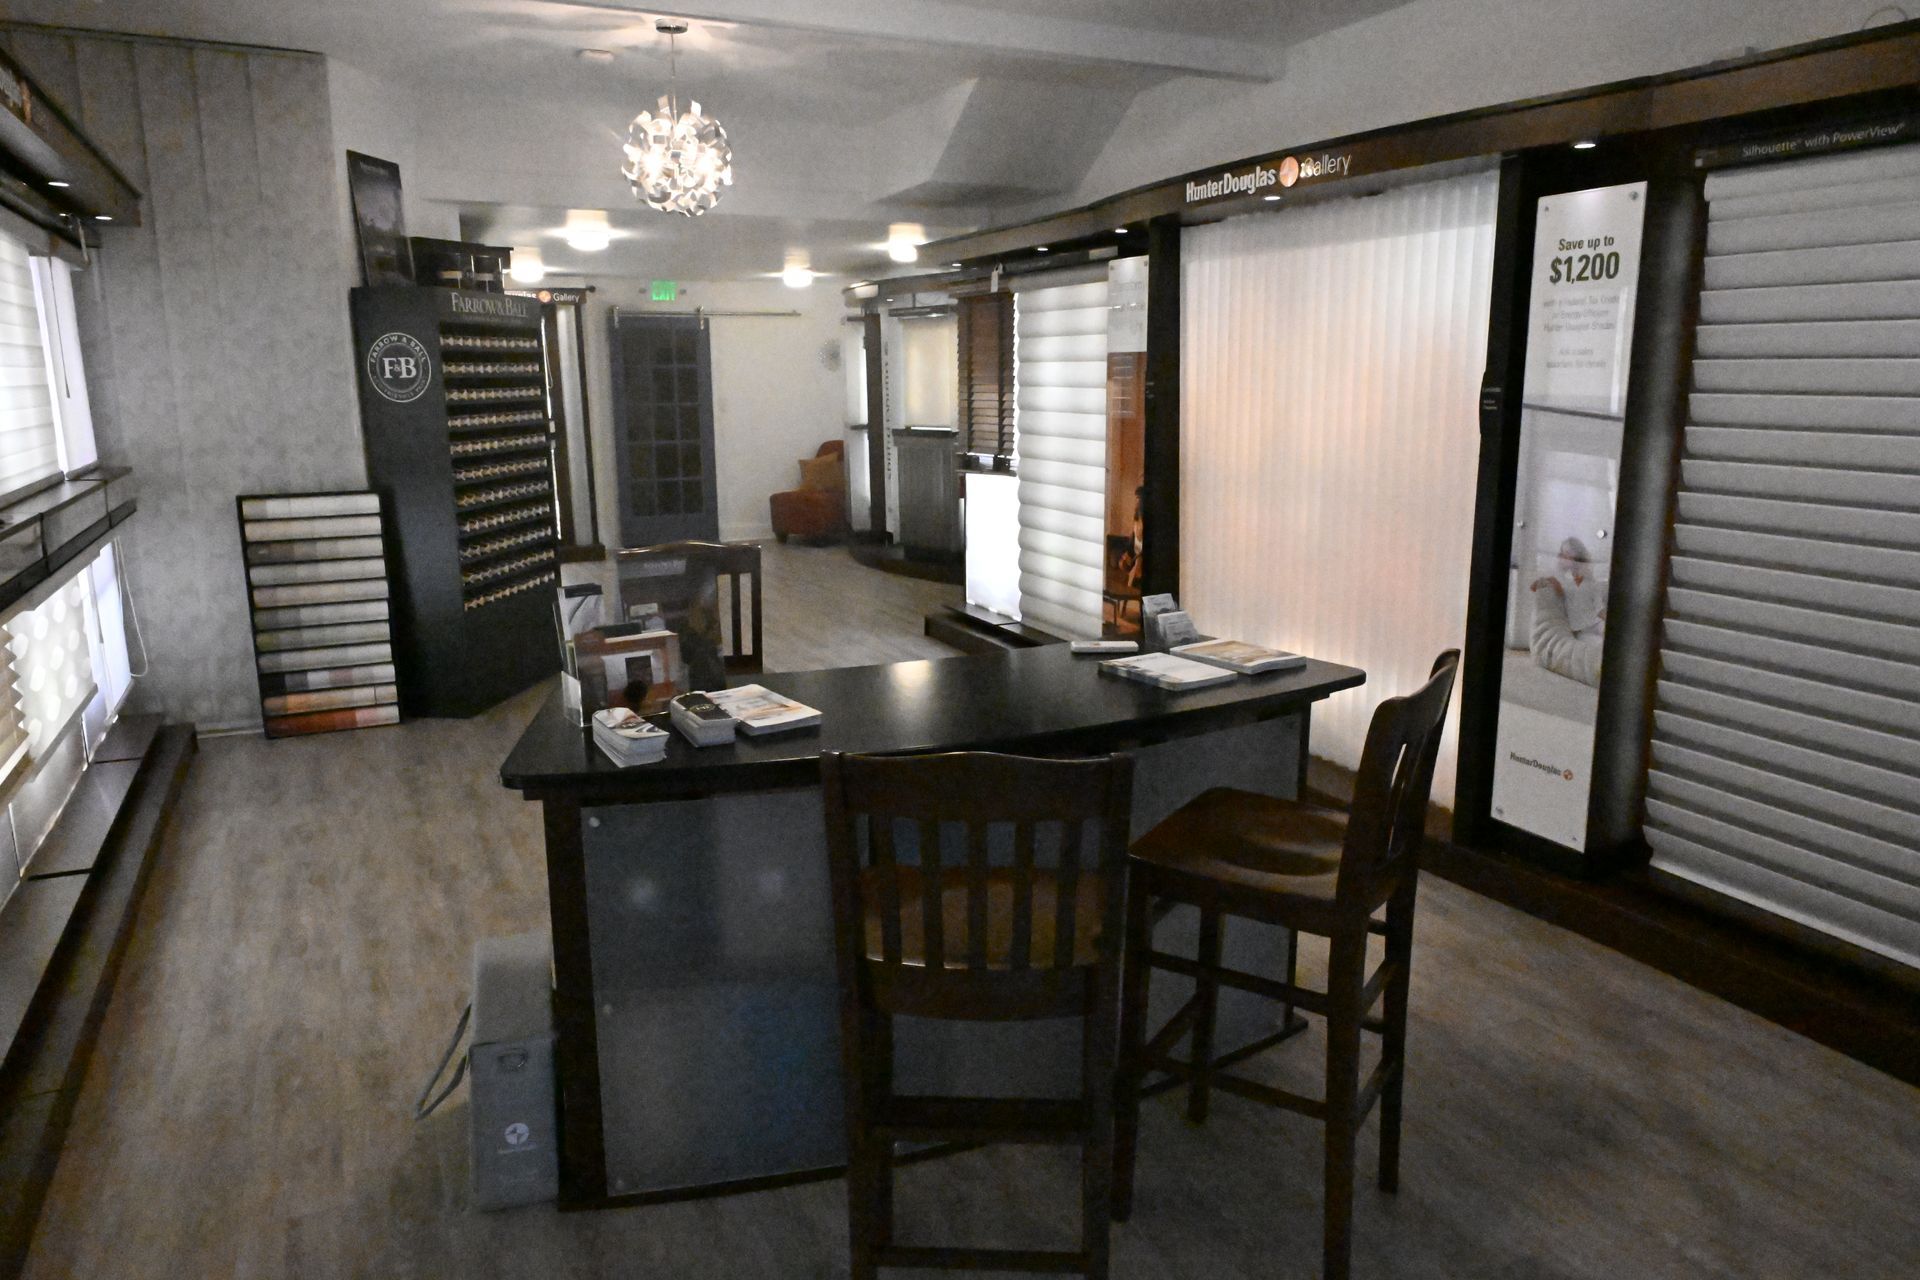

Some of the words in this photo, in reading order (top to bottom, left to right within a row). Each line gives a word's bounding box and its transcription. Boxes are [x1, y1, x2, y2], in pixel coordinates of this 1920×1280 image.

[1805, 134, 1830, 147] with
[1186, 166, 1276, 203] HunterDouglas
[1304, 153, 1352, 177] Gallery
[1558, 237, 1584, 251] Save
[1588, 237, 1601, 251] up
[1604, 235, 1614, 247] to
[1549, 252, 1620, 284] $1,200
[553, 293, 580, 303] Gallery
[652, 281, 676, 301] EXIT
[370, 335, 398, 363] FARROW
[410, 340, 426, 362] BALL
[383, 357, 417, 379] F&B
